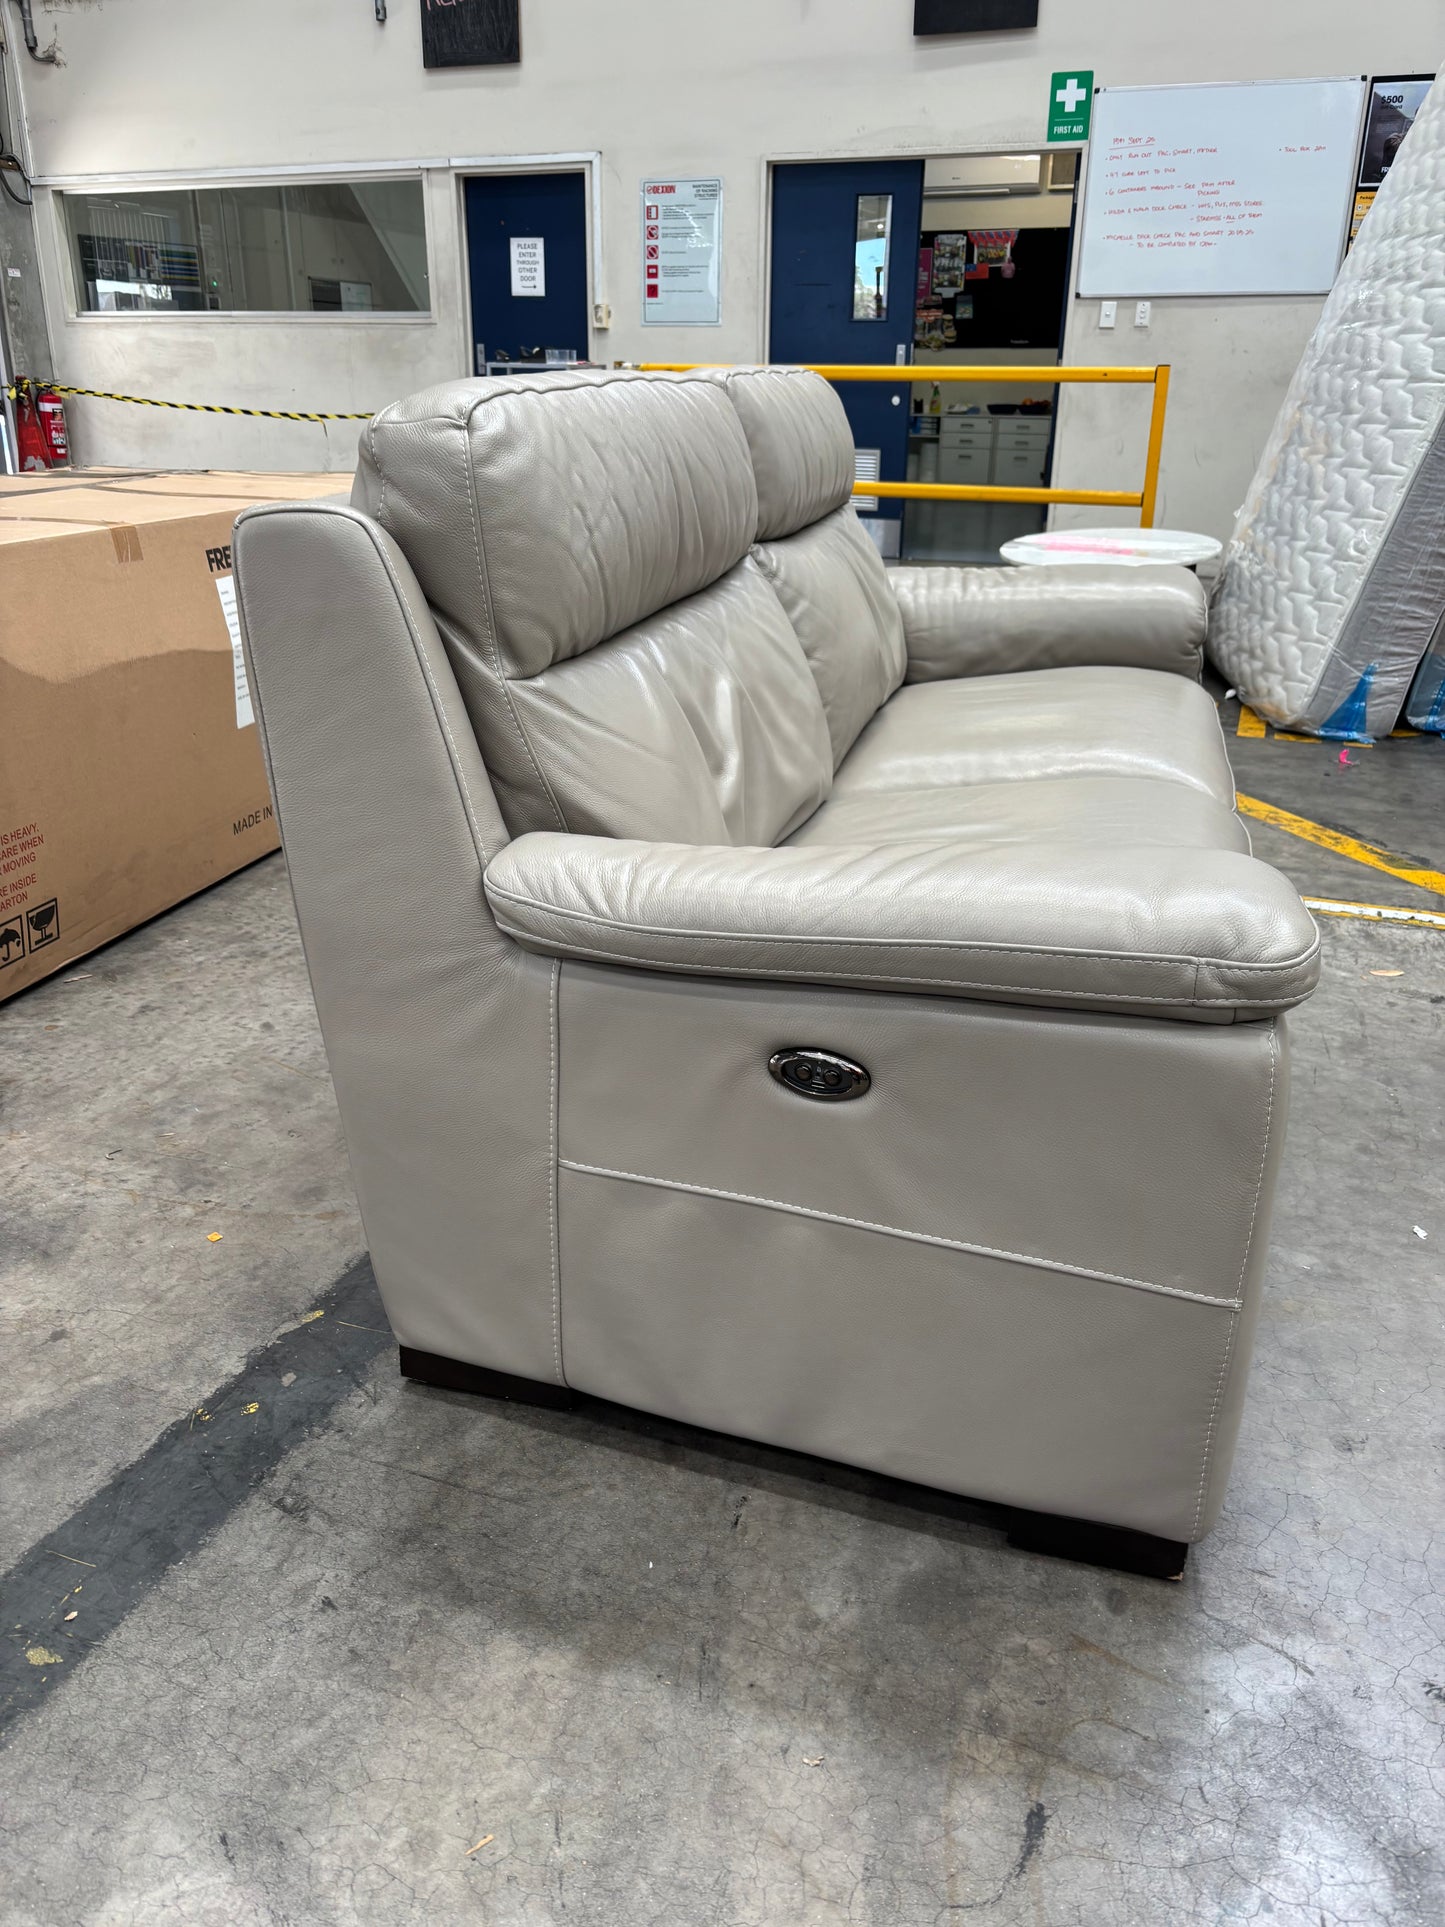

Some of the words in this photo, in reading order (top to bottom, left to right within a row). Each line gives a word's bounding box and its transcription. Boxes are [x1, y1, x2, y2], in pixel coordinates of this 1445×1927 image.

[1381, 95, 1404, 104] $500
[1054, 126, 1071, 134] FIRST
[1072, 125, 1084, 134] AID
[233, 810, 261, 836] MADE
[263, 804, 272, 820] IN
[0, 834, 10, 846] IS
[10, 822, 39, 842] HEAVY.
[20, 834, 44, 852] WHEN
[3, 852, 36, 874] MOVING
[10, 873, 37, 893] INSIDE
